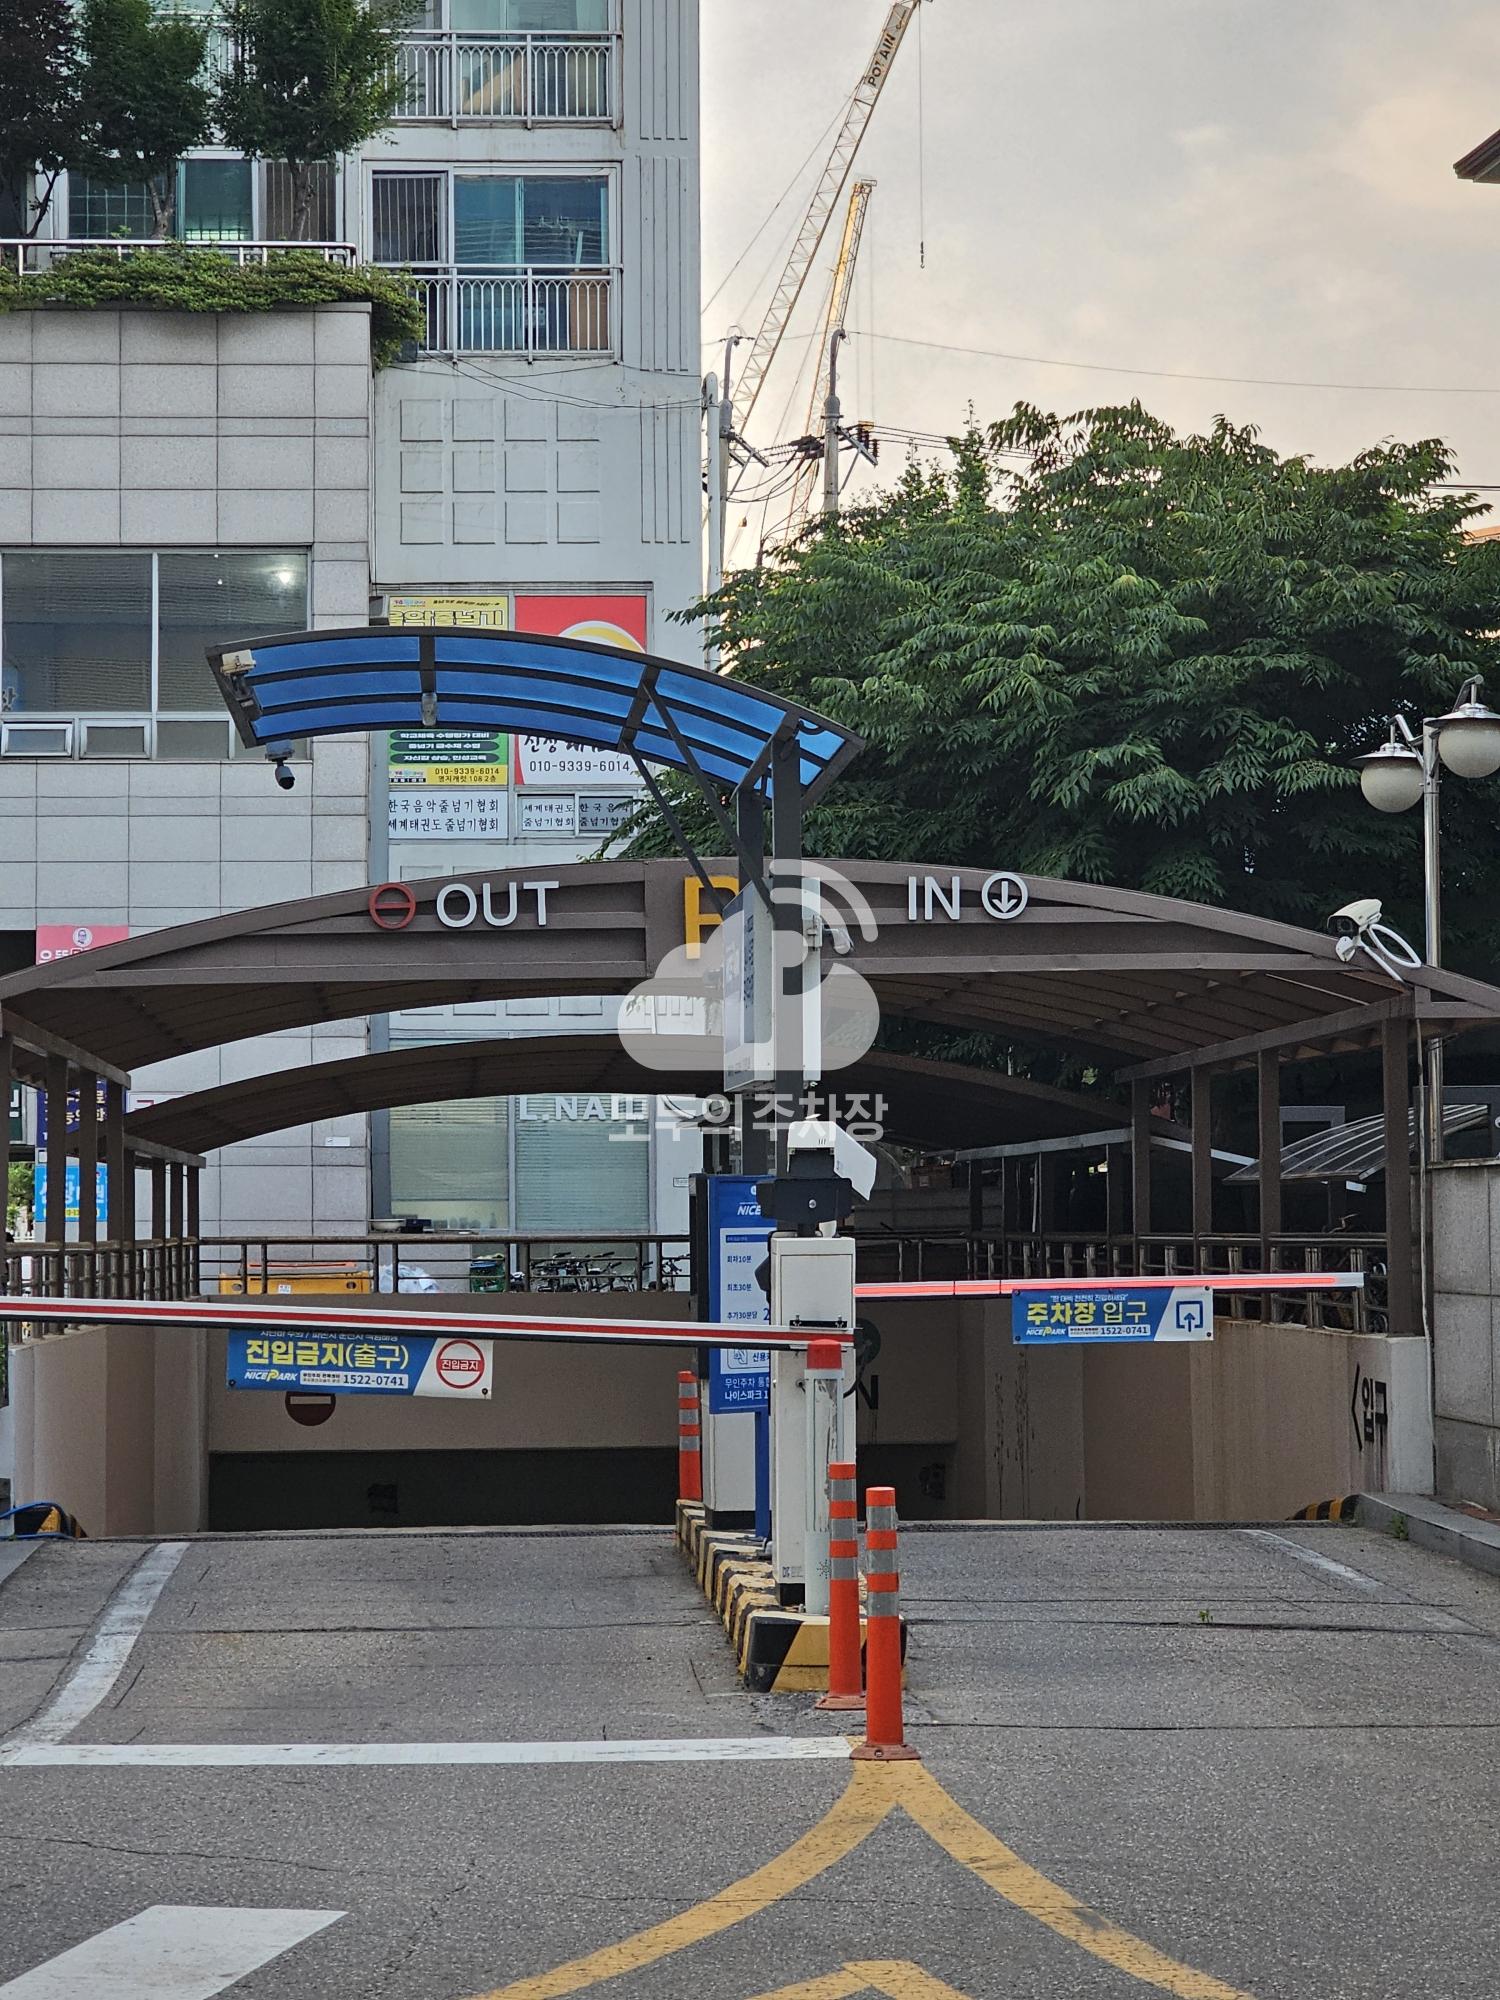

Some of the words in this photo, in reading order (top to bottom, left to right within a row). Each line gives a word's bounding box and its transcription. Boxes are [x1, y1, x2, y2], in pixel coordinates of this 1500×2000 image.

[529, 760, 630, 772] 010-9339-6014
[388, 818, 442, 832] 세계태권도
[444, 818, 499, 832] 줄넘기협회
[524, 817, 575, 827] 줄넘기협회
[908, 876, 960, 920] IN
[436, 881, 559, 928] OUT
[1027, 1302, 1096, 1326] 주차장
[1103, 1301, 1148, 1324] 입구
[1100, 1326, 1148, 1335] 1522-0741
[246, 1339, 409, 1370] 진입금지(출구)
[441, 1359, 479, 1371] 진입금지
[343, 1374, 404, 1386] 1522-0741
[724, 1390, 762, 1402] 나이스파크
